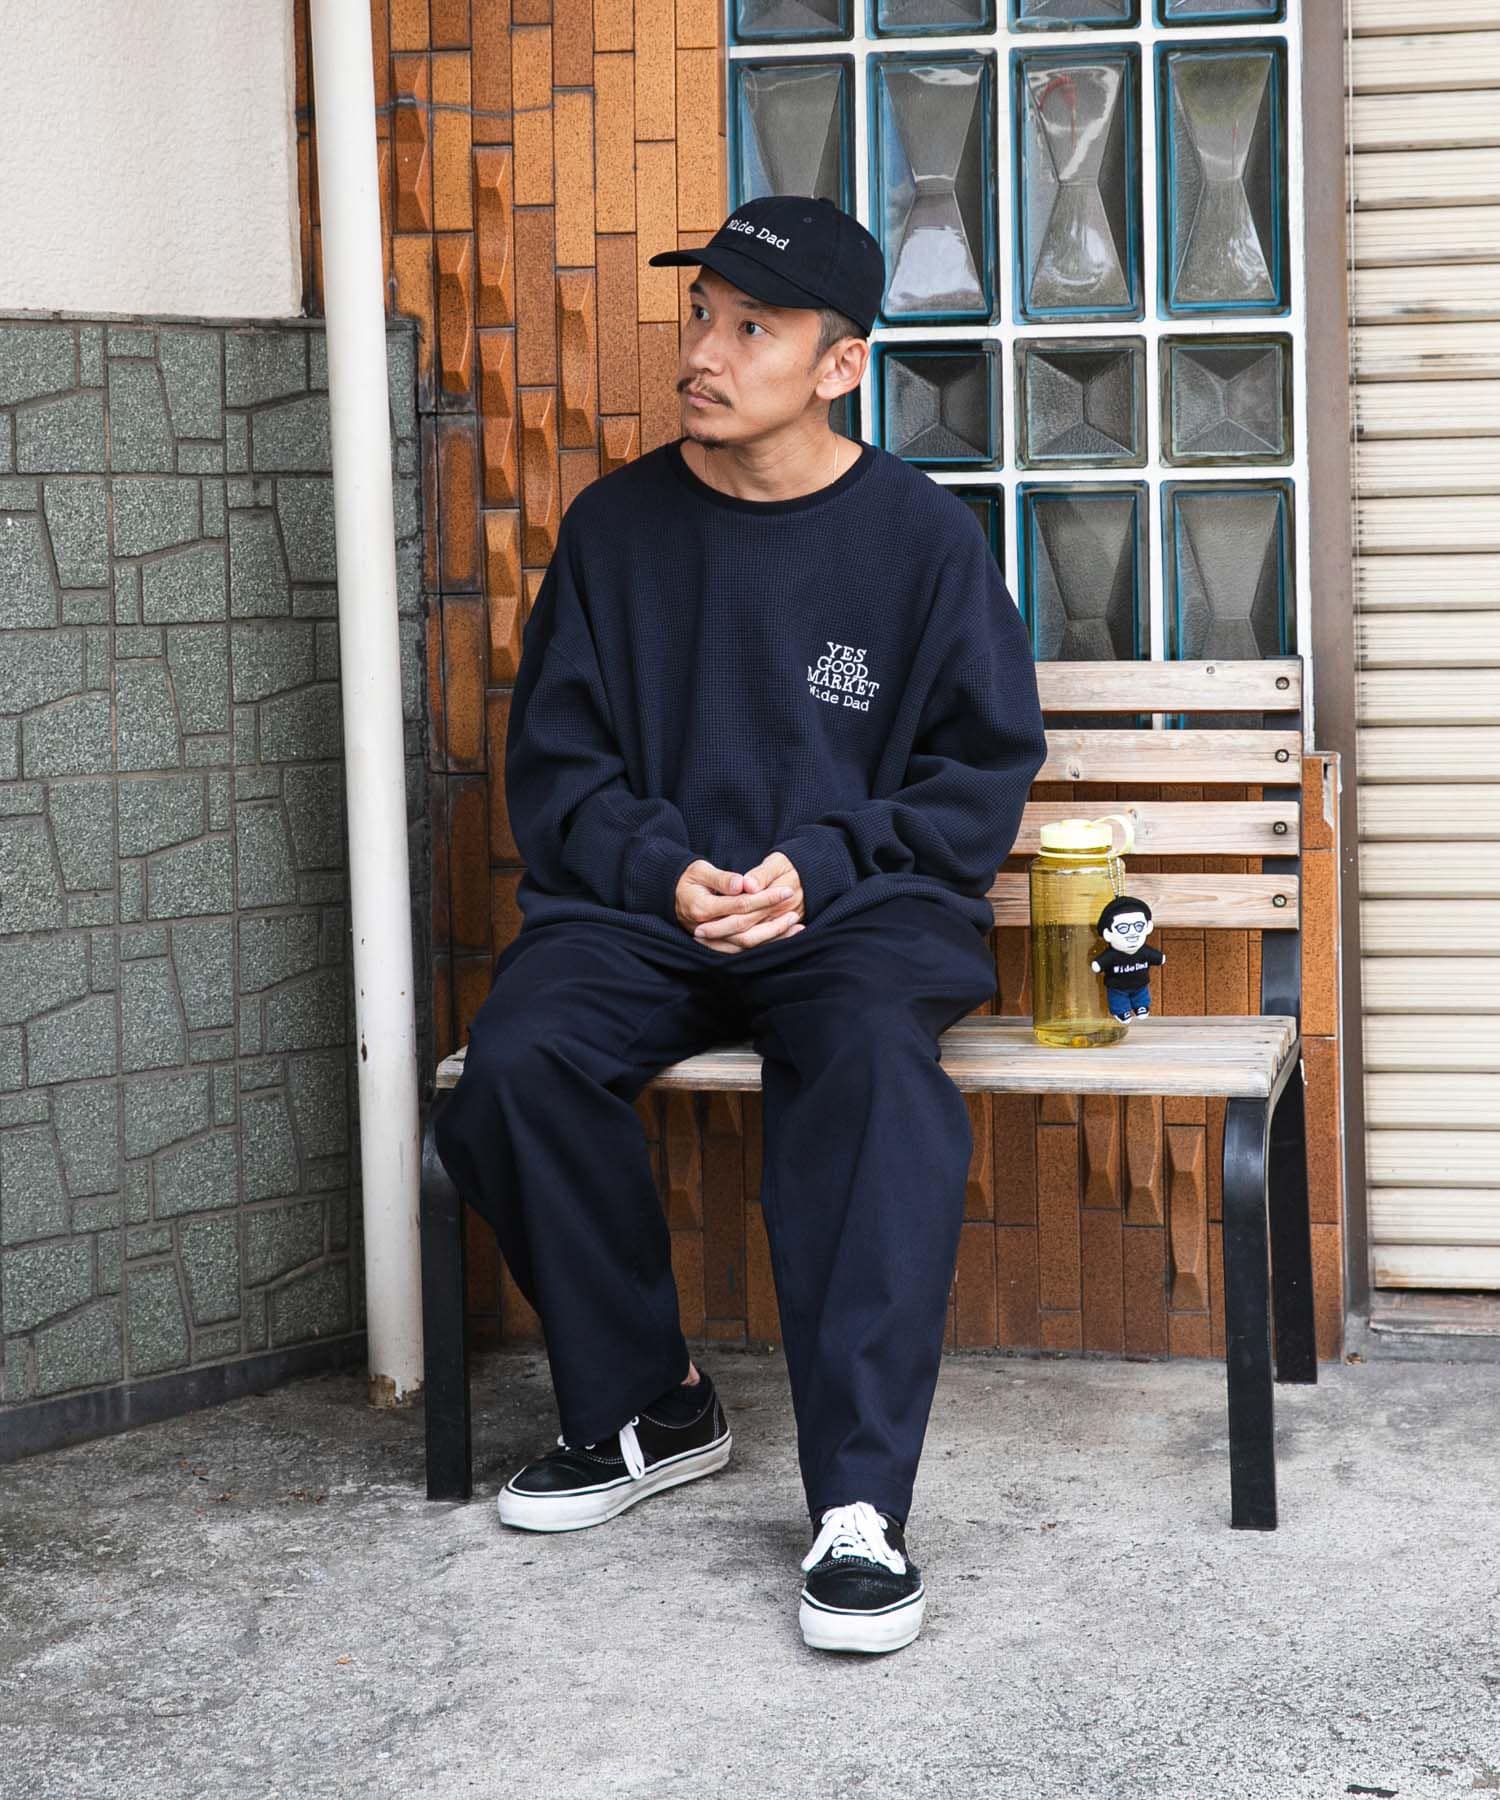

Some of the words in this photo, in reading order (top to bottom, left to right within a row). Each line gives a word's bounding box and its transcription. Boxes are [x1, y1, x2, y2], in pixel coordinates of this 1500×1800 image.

[756, 227, 790, 251] Dad
[826, 641, 867, 663] YES
[817, 655, 869, 679] GOOD
[807, 665, 880, 697] MARKET
[808, 684, 839, 704] Wide
[842, 695, 870, 712] Dad
